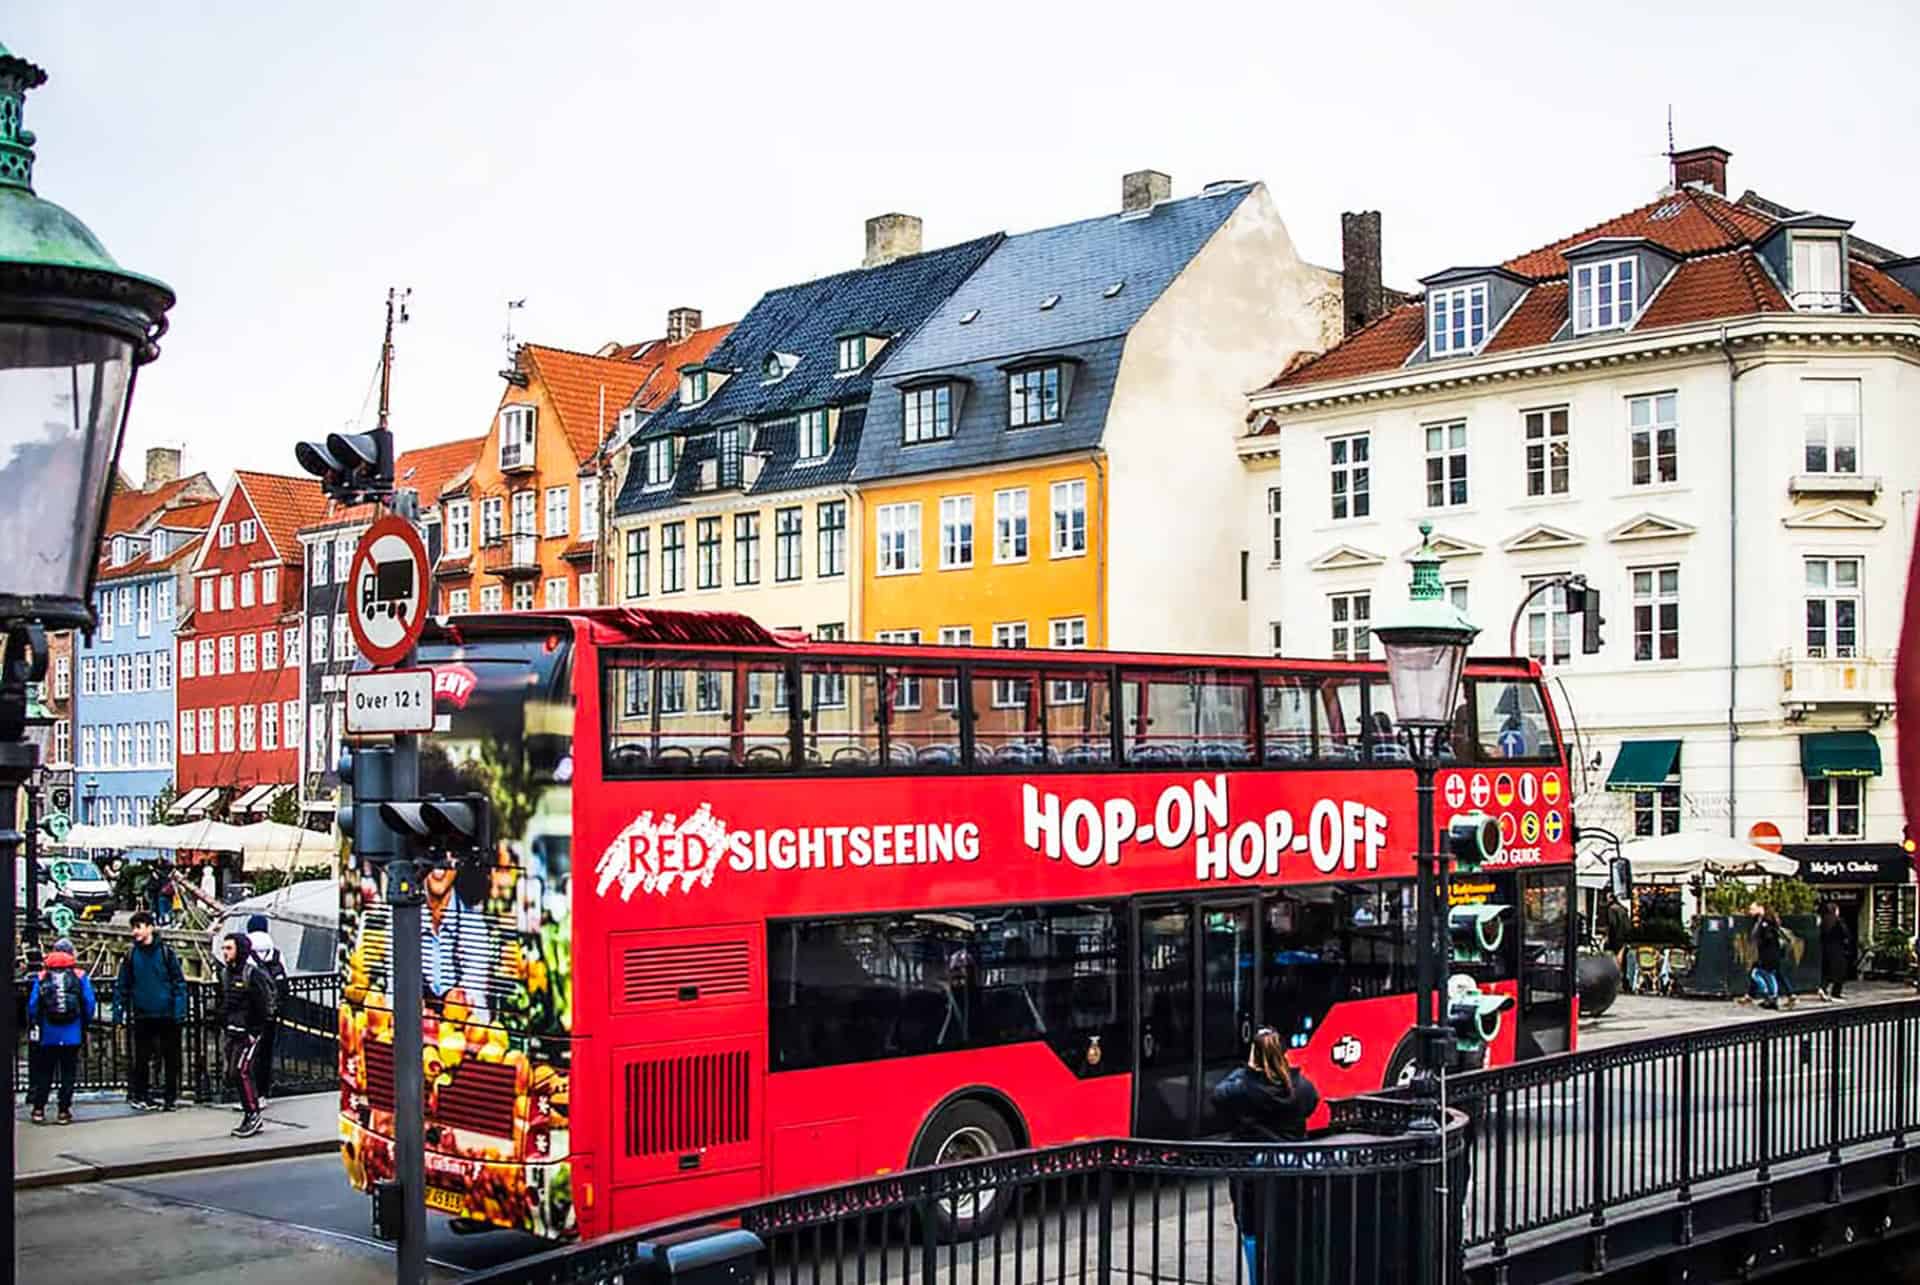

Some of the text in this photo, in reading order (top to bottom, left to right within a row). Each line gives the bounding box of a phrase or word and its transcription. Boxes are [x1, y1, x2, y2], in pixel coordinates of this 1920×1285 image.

[356, 690, 421, 710] Over 12 t
[435, 672, 470, 697] ENY
[1022, 773, 1229, 867] HOP-ON
[1195, 798, 1388, 881] HOP-OFF
[627, 822, 980, 875] RED SIGHTSEEING
[1510, 847, 1541, 864] GUIDE
